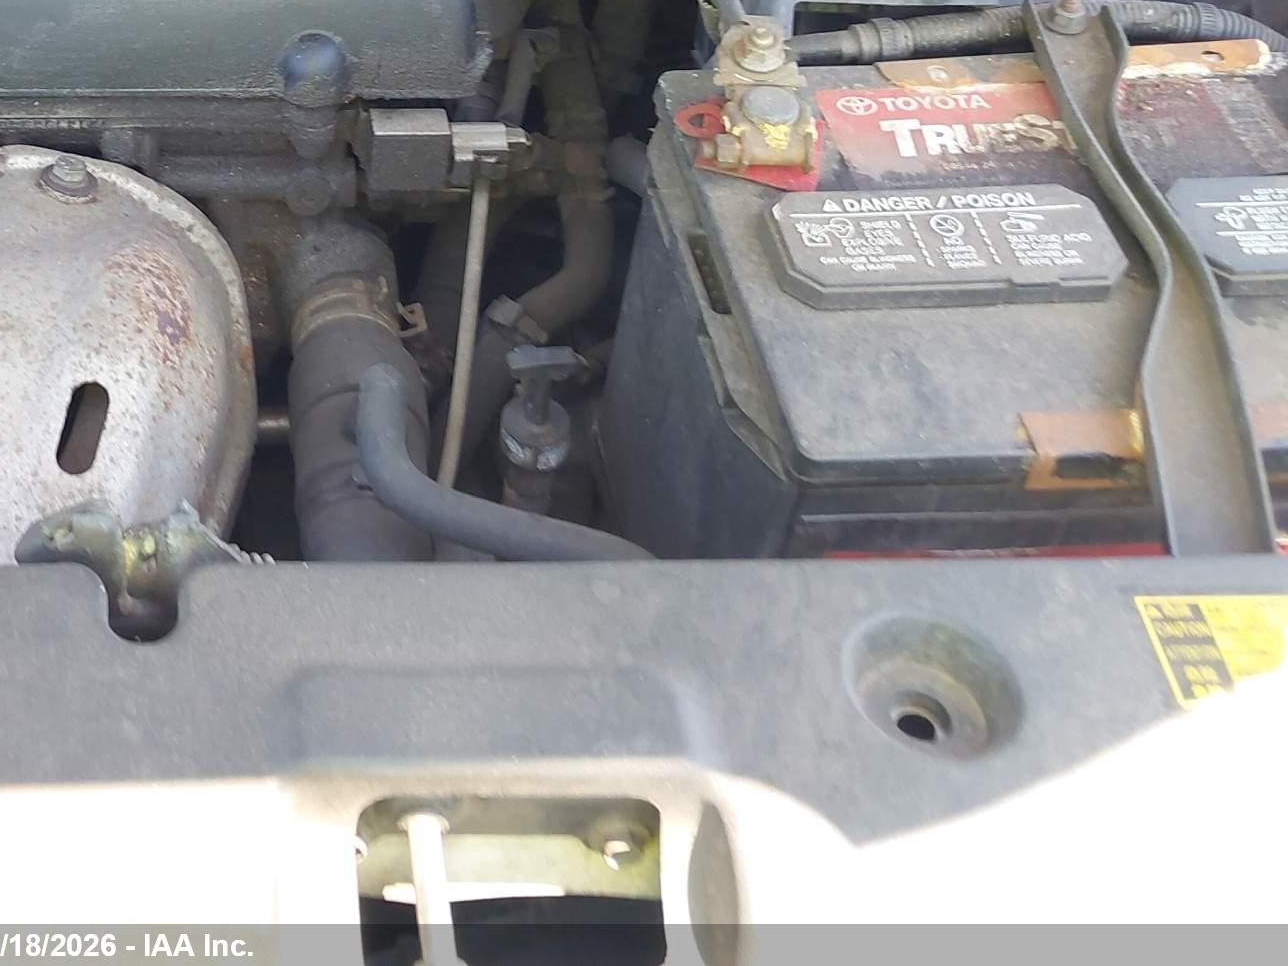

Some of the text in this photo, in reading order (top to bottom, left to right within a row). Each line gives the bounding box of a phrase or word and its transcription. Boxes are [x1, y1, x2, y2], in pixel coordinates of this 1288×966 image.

[881, 94, 992, 111] TOYOTA
[843, 196, 933, 212] DANGER
[951, 192, 1037, 208] POISON
